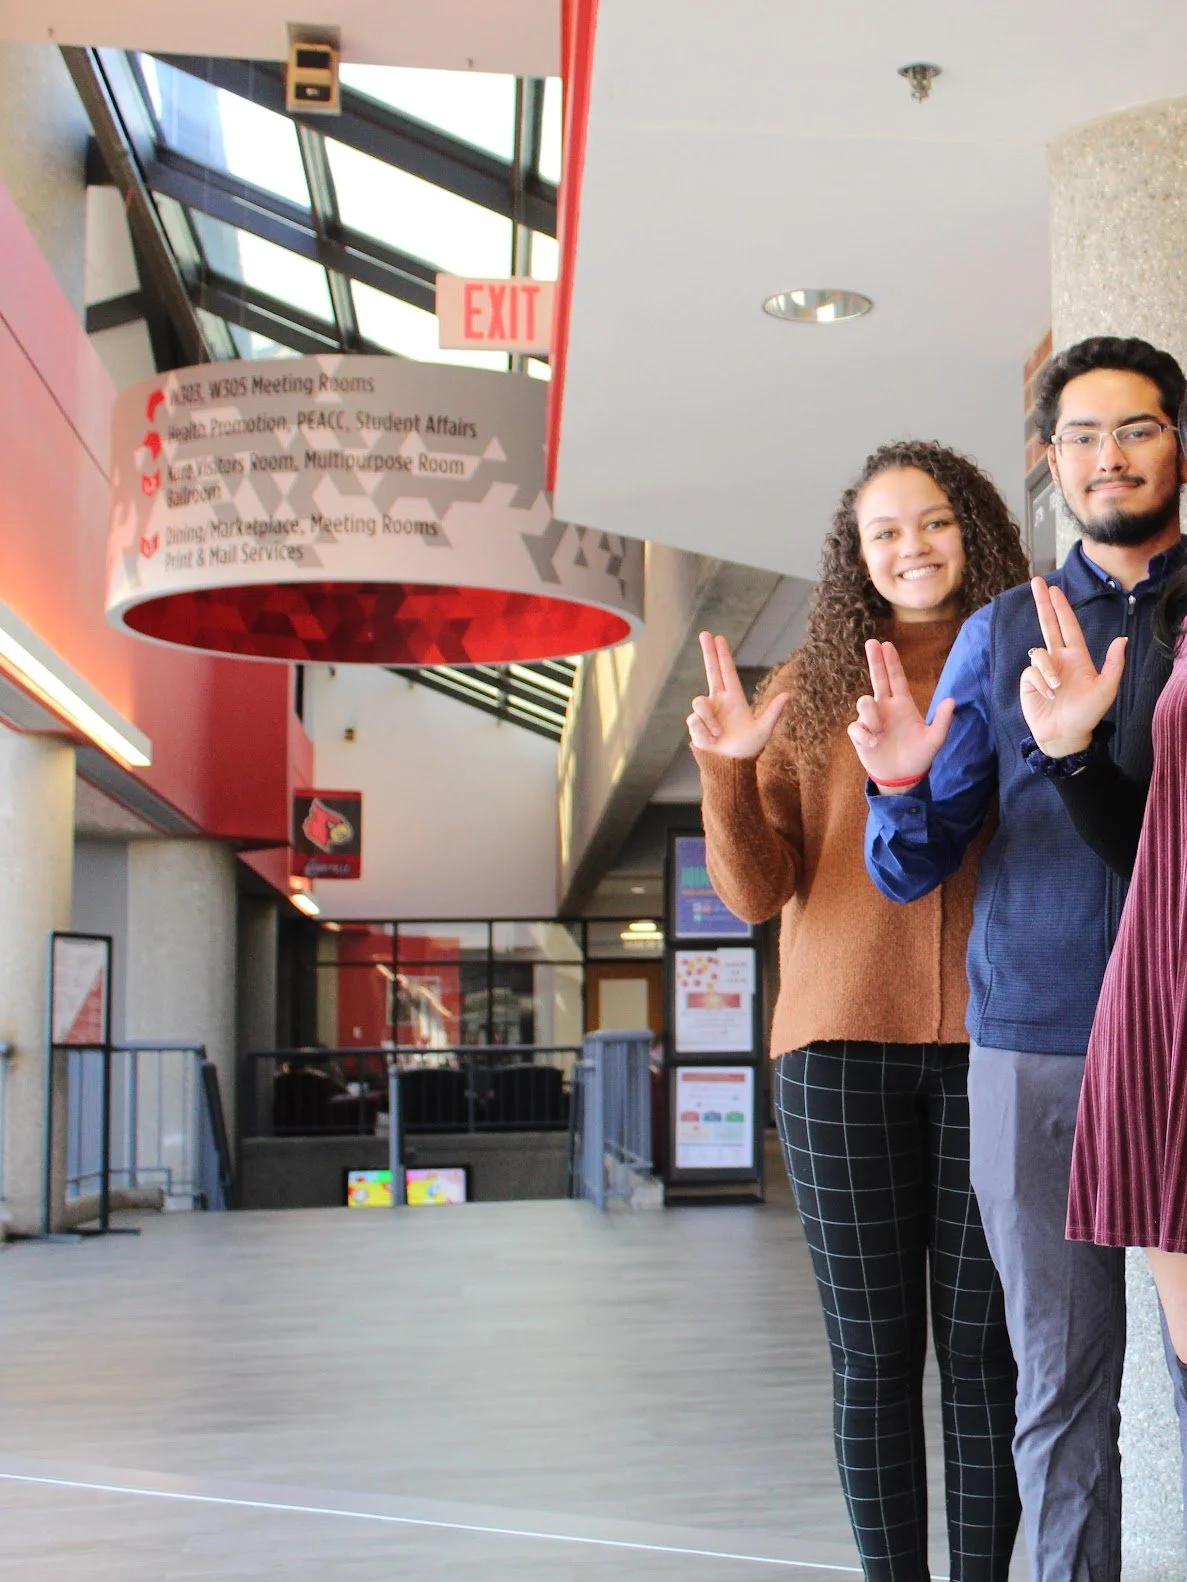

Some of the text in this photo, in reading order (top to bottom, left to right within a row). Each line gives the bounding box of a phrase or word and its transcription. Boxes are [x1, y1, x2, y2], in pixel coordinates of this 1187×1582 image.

[464, 283, 541, 341] EXIT
[208, 376, 247, 399] W305
[251, 374, 314, 396] Meeting
[319, 372, 375, 393] Rooms
[168, 421, 207, 443] Health
[356, 411, 421, 433] Student
[425, 414, 477, 438] Affairs
[249, 451, 299, 472] Room,
[304, 448, 412, 472] Multipurpose
[419, 452, 464, 475] Room
[167, 485, 221, 509] Ballroom
[208, 514, 304, 538] Marketplace,
[310, 512, 376, 538] Meeting
[382, 513, 438, 536] Rooms
[165, 541, 304, 571] Print & Mail Services
